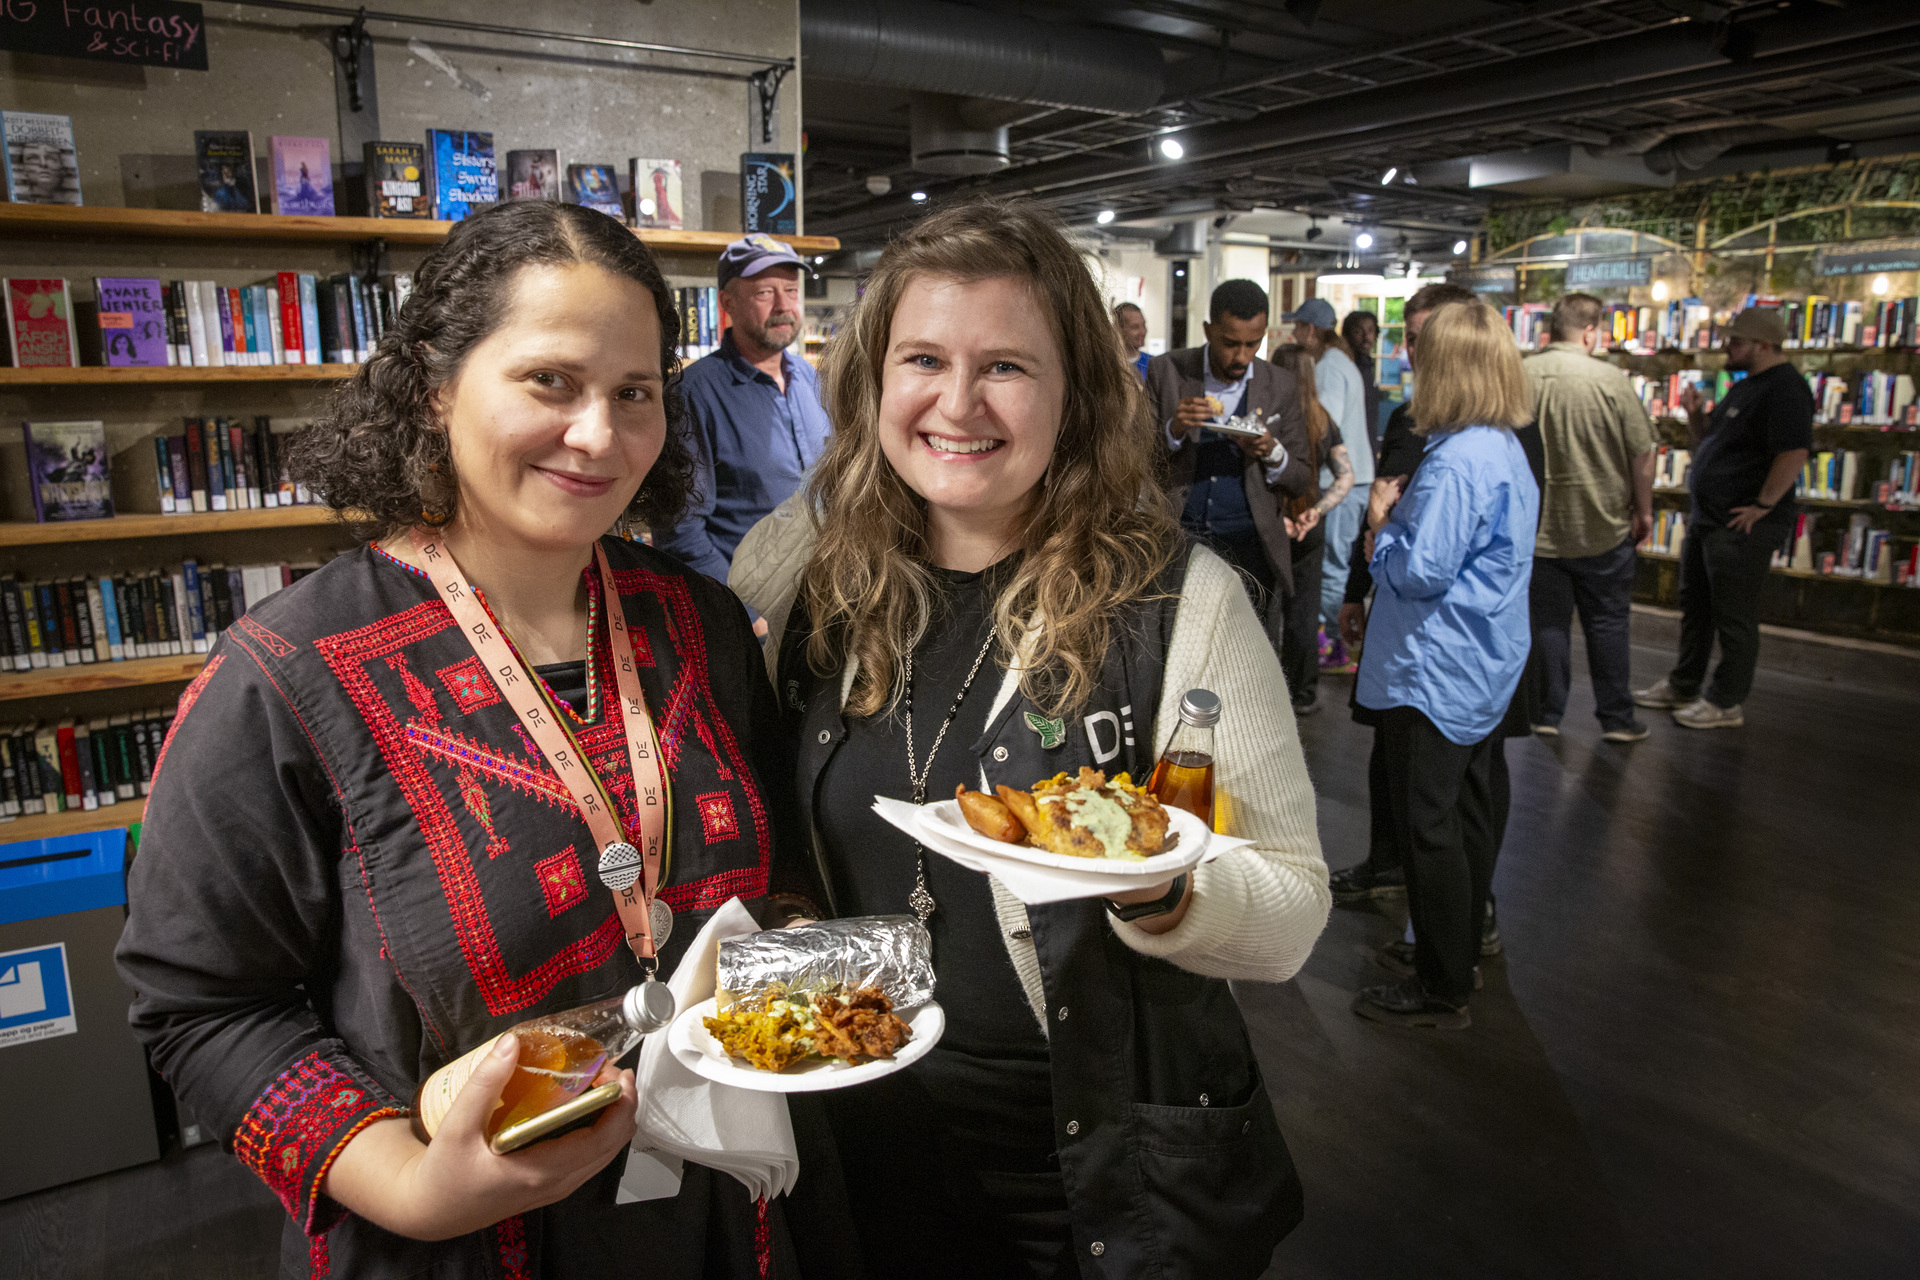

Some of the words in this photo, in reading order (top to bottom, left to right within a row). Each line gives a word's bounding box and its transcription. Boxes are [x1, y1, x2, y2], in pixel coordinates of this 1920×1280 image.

[63, 0, 199, 50] Fantasy
[87, 31, 107, 51] &
[376, 146, 410, 156] SARAH
[384, 155, 412, 164] MAAS
[453, 151, 497, 168] Sisters
[457, 170, 497, 186] Sword
[756, 165, 769, 194] STAR
[382, 180, 420, 198] KINGDOM
[448, 187, 498, 203] Shadow
[745, 174, 760, 232] MORNING
[104, 287, 152, 300] SVAKE
[101, 300, 162, 313] JENTER
[19, 331, 66, 343] AFGH
[20, 342, 66, 354] ANSKE
[424, 543, 441, 562] DE
[446, 581, 465, 602] DE
[613, 613, 623, 631] DE
[472, 622, 492, 644] DE
[620, 654, 632, 672] DE
[499, 665, 519, 686] DE
[630, 697, 641, 715] DE
[527, 708, 546, 728] DE
[1083, 704, 1135, 764] DE
[638, 741, 650, 759] DE
[555, 750, 574, 770] DE
[583, 794, 600, 814] DE
[644, 786, 657, 806] DE
[649, 837, 659, 856] DE
